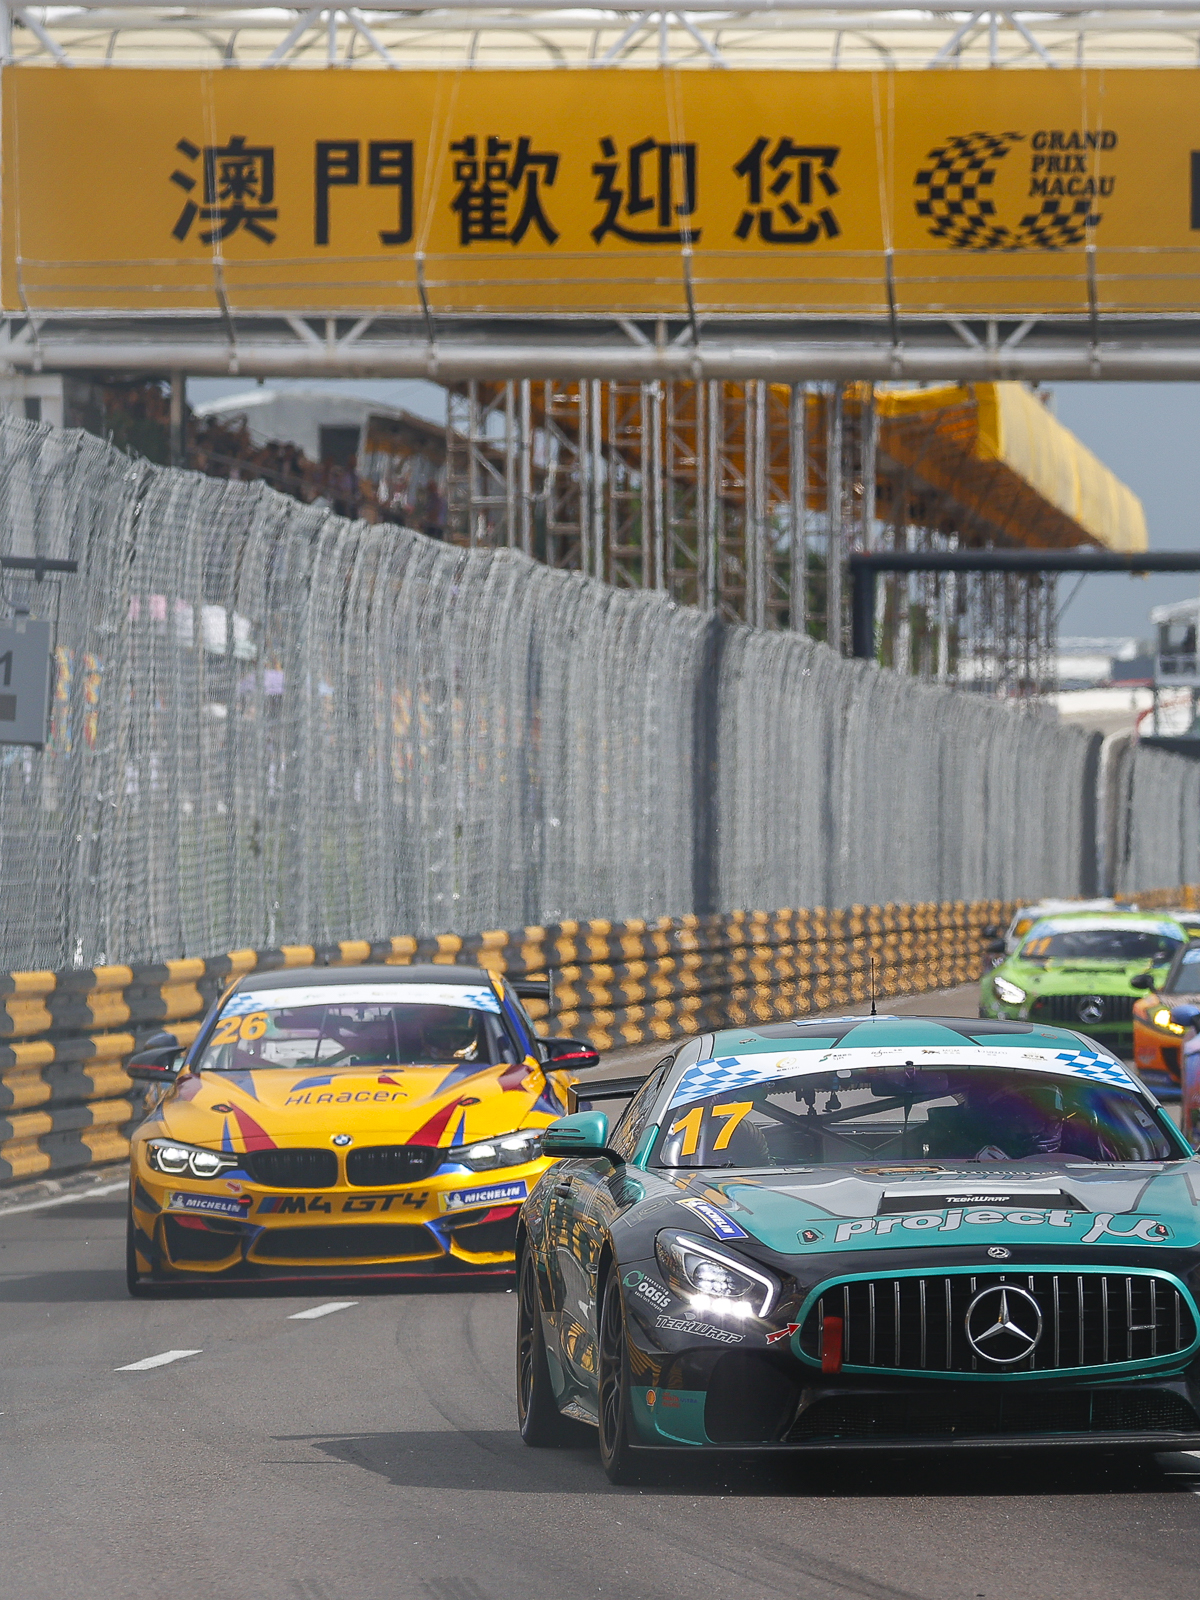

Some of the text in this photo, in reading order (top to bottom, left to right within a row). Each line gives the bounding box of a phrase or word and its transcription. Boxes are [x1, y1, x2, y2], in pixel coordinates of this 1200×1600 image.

[1031, 130, 1118, 150] GRAND
[1031, 154, 1087, 174] PRIX
[168, 135, 842, 246] 澳門歡迎您
[1028, 175, 1117, 198] MACAU
[209, 1011, 269, 1047] 26
[672, 1101, 754, 1156] 17
[185, 1198, 242, 1213] MICHELIN
[277, 1191, 430, 1214] M4 GT4
[464, 1186, 520, 1203] MICHELIN
[833, 1208, 1075, 1243] project
[638, 1282, 672, 1308] oasis
